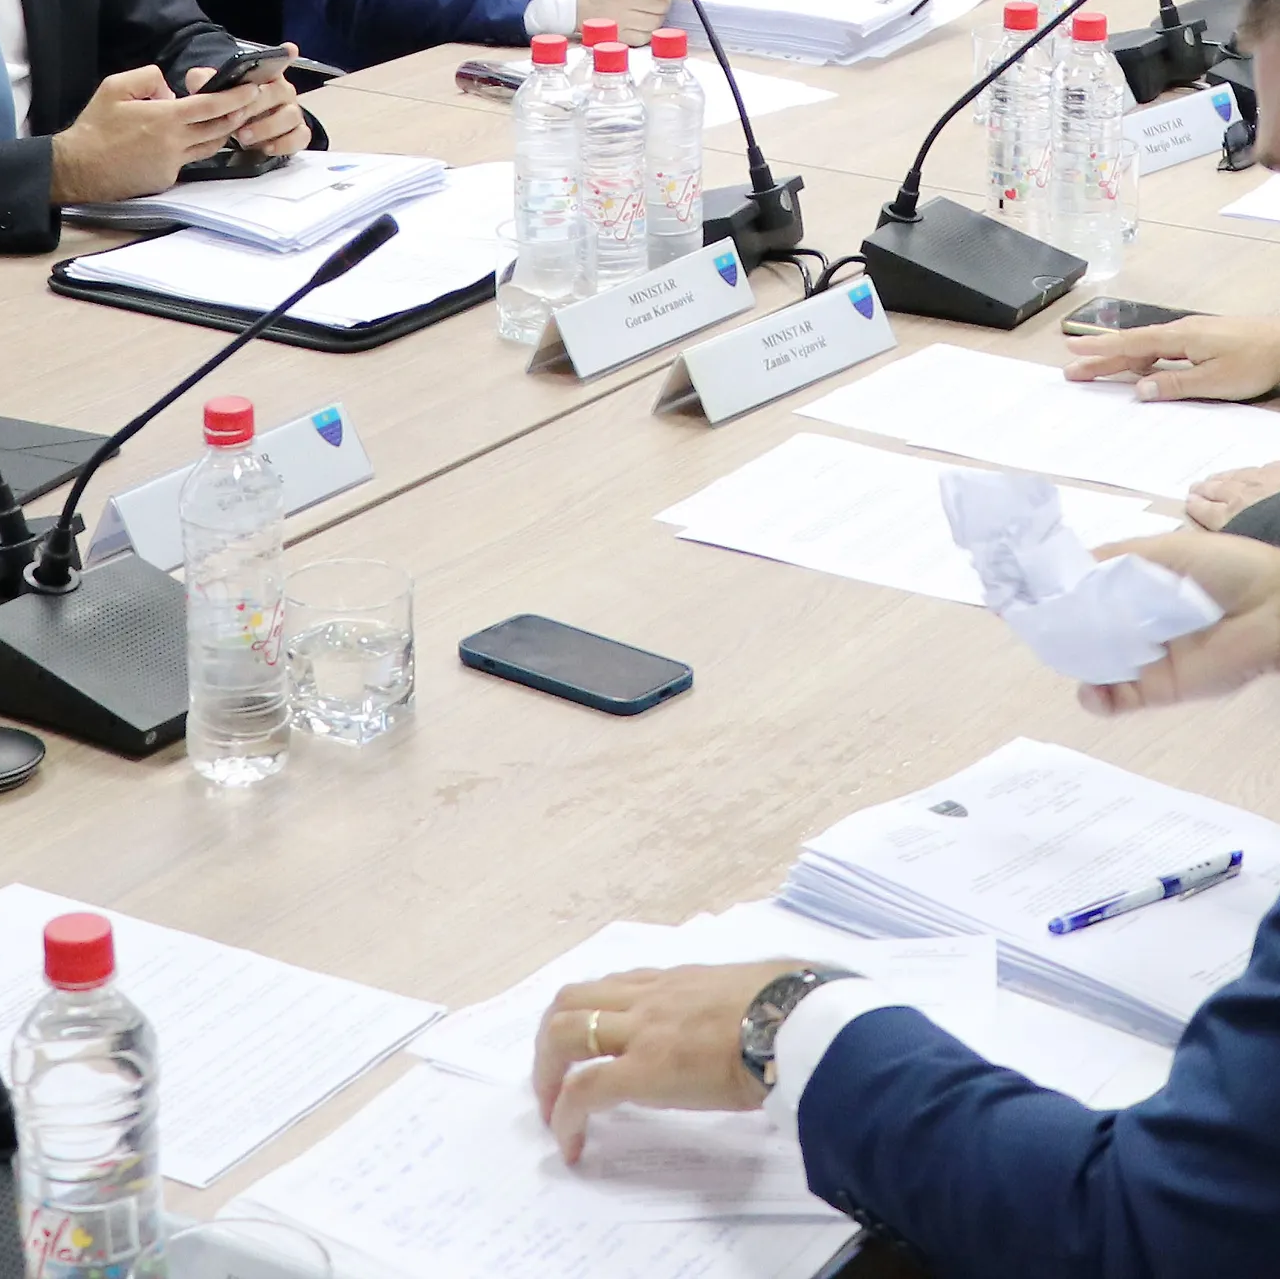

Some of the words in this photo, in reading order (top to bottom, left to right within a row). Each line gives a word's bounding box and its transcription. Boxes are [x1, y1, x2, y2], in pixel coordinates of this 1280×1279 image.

[1142, 118, 1184, 137] MINISTAR
[628, 278, 678, 306] MINISTAR
[625, 304, 653, 330] Goran
[652, 290, 695, 319] Karanović
[761, 320, 814, 350] MINISTAR
[763, 349, 791, 372] Zanin
[790, 335, 828, 363] Vejzović
